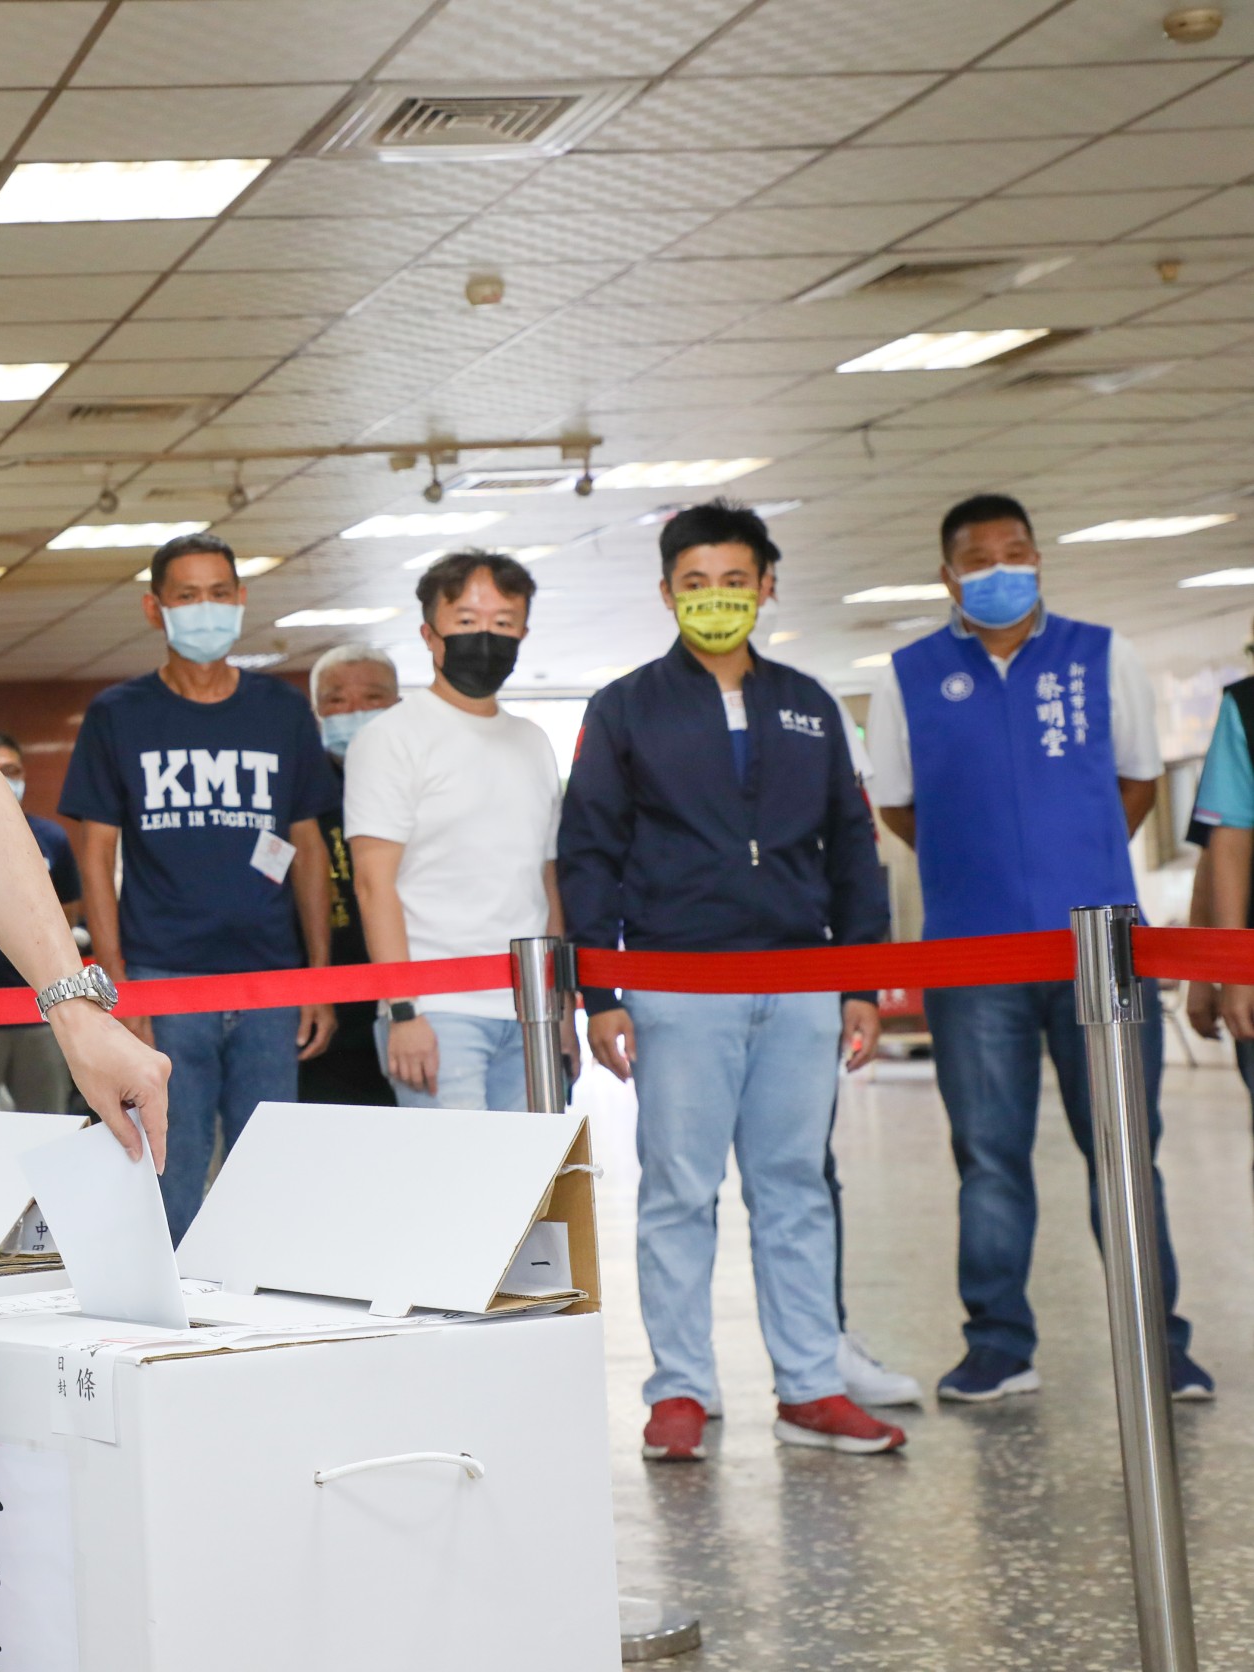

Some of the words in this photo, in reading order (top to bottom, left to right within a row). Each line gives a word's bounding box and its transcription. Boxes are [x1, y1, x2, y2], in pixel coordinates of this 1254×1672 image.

[779, 709, 823, 731] KMT
[140, 749, 279, 810] KMT
[141, 811, 182, 831] LEAN
[188, 811, 206, 827] IN
[76, 1367, 97, 1402] 條
